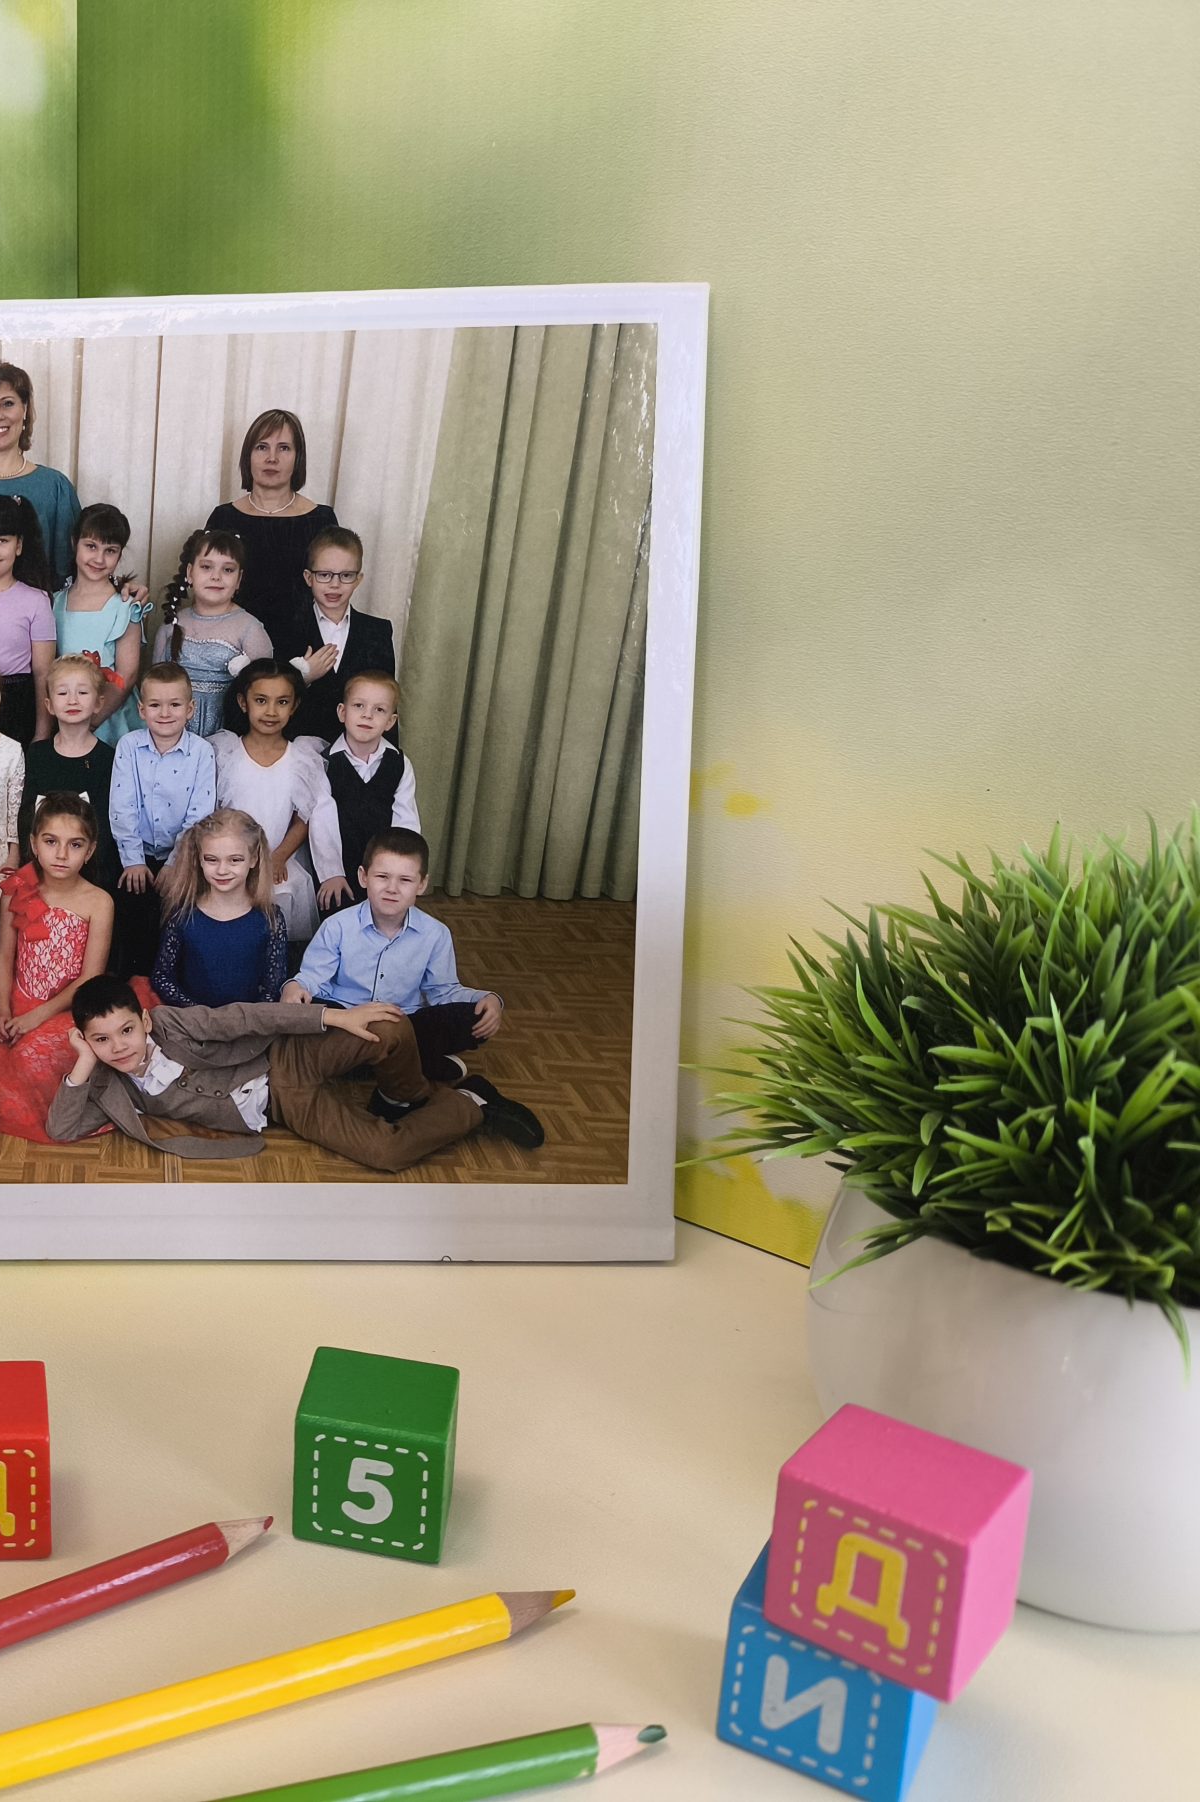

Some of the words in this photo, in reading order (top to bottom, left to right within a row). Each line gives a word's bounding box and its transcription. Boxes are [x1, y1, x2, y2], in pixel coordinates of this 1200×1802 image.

[341, 1457, 394, 1525] 5
[816, 1532, 910, 1649] Д
[760, 1654, 848, 1755] И
